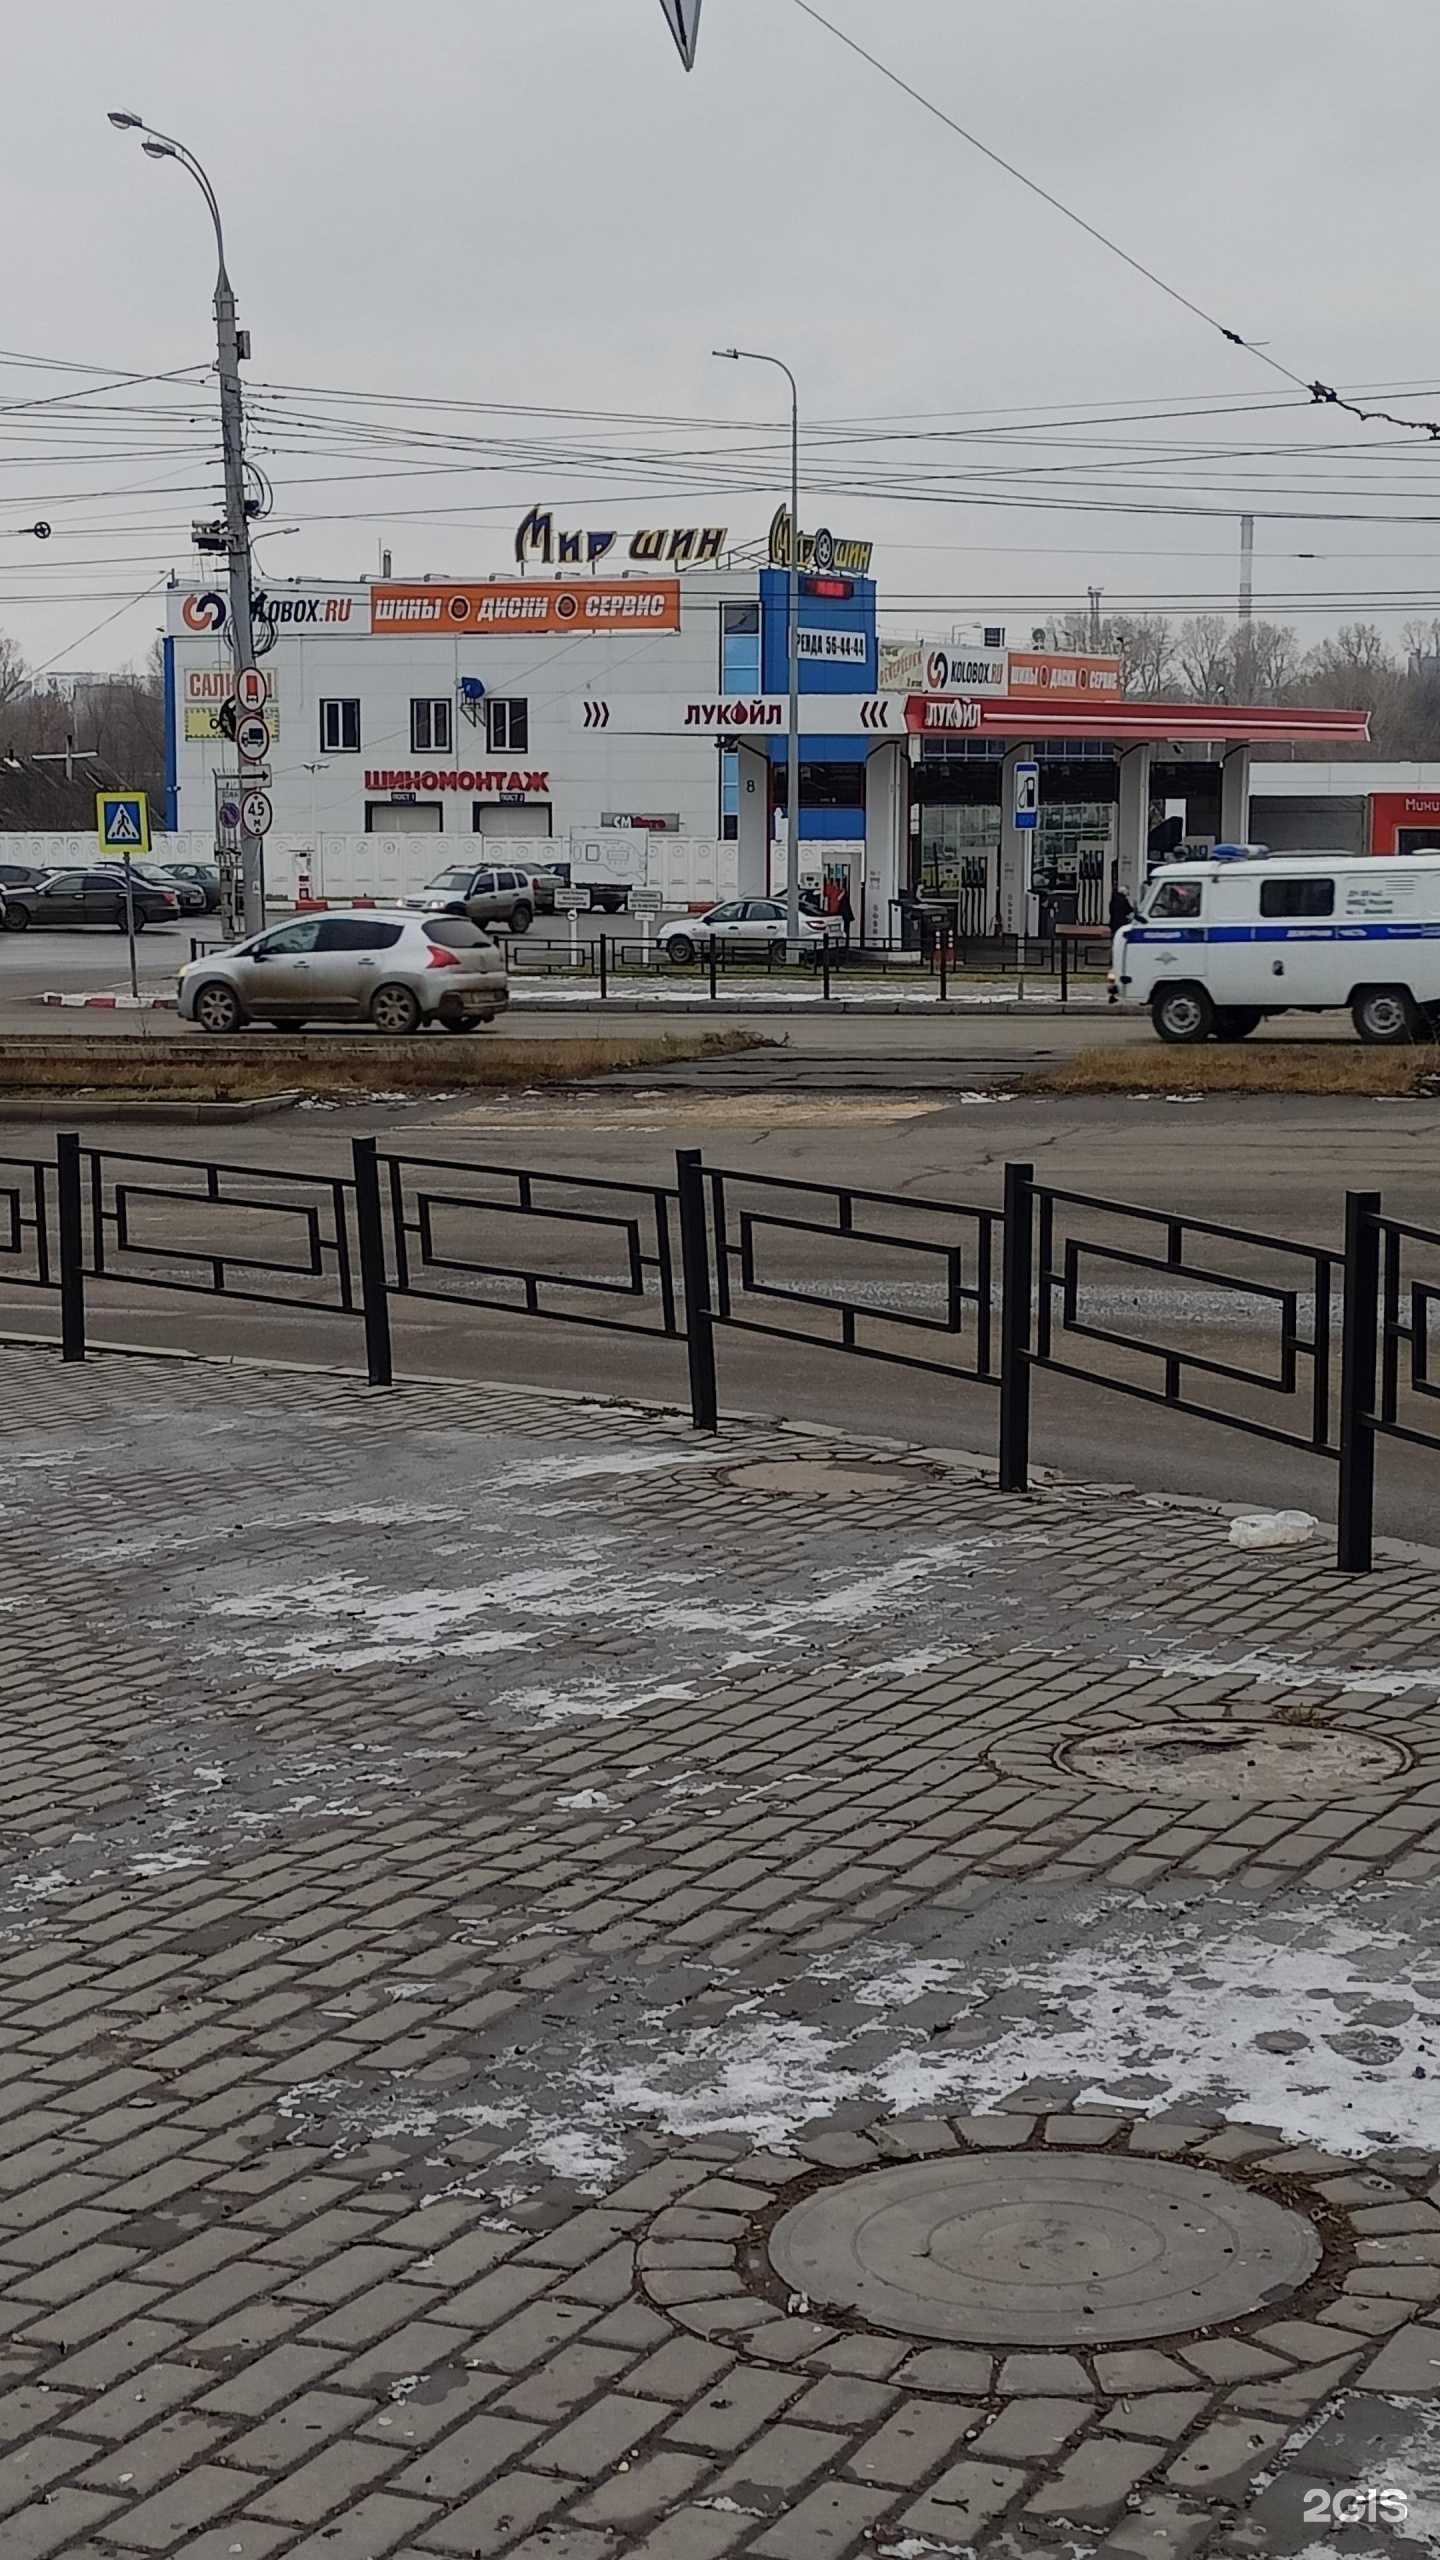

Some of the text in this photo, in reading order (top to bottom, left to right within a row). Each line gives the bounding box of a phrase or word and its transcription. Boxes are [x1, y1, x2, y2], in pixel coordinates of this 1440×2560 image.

[375, 594, 665, 622] ШИНЫ ДИСКИ СЕРВИС
[826, 635, 864, 657] 56-44-44
[684, 699, 782, 725] ЛУКОЙЛ
[924, 697, 982, 729] ЛУКОЙЛ
[364, 770, 551, 793] ШИНОМОНТАЖ
[746, 779, 756, 794] 8
